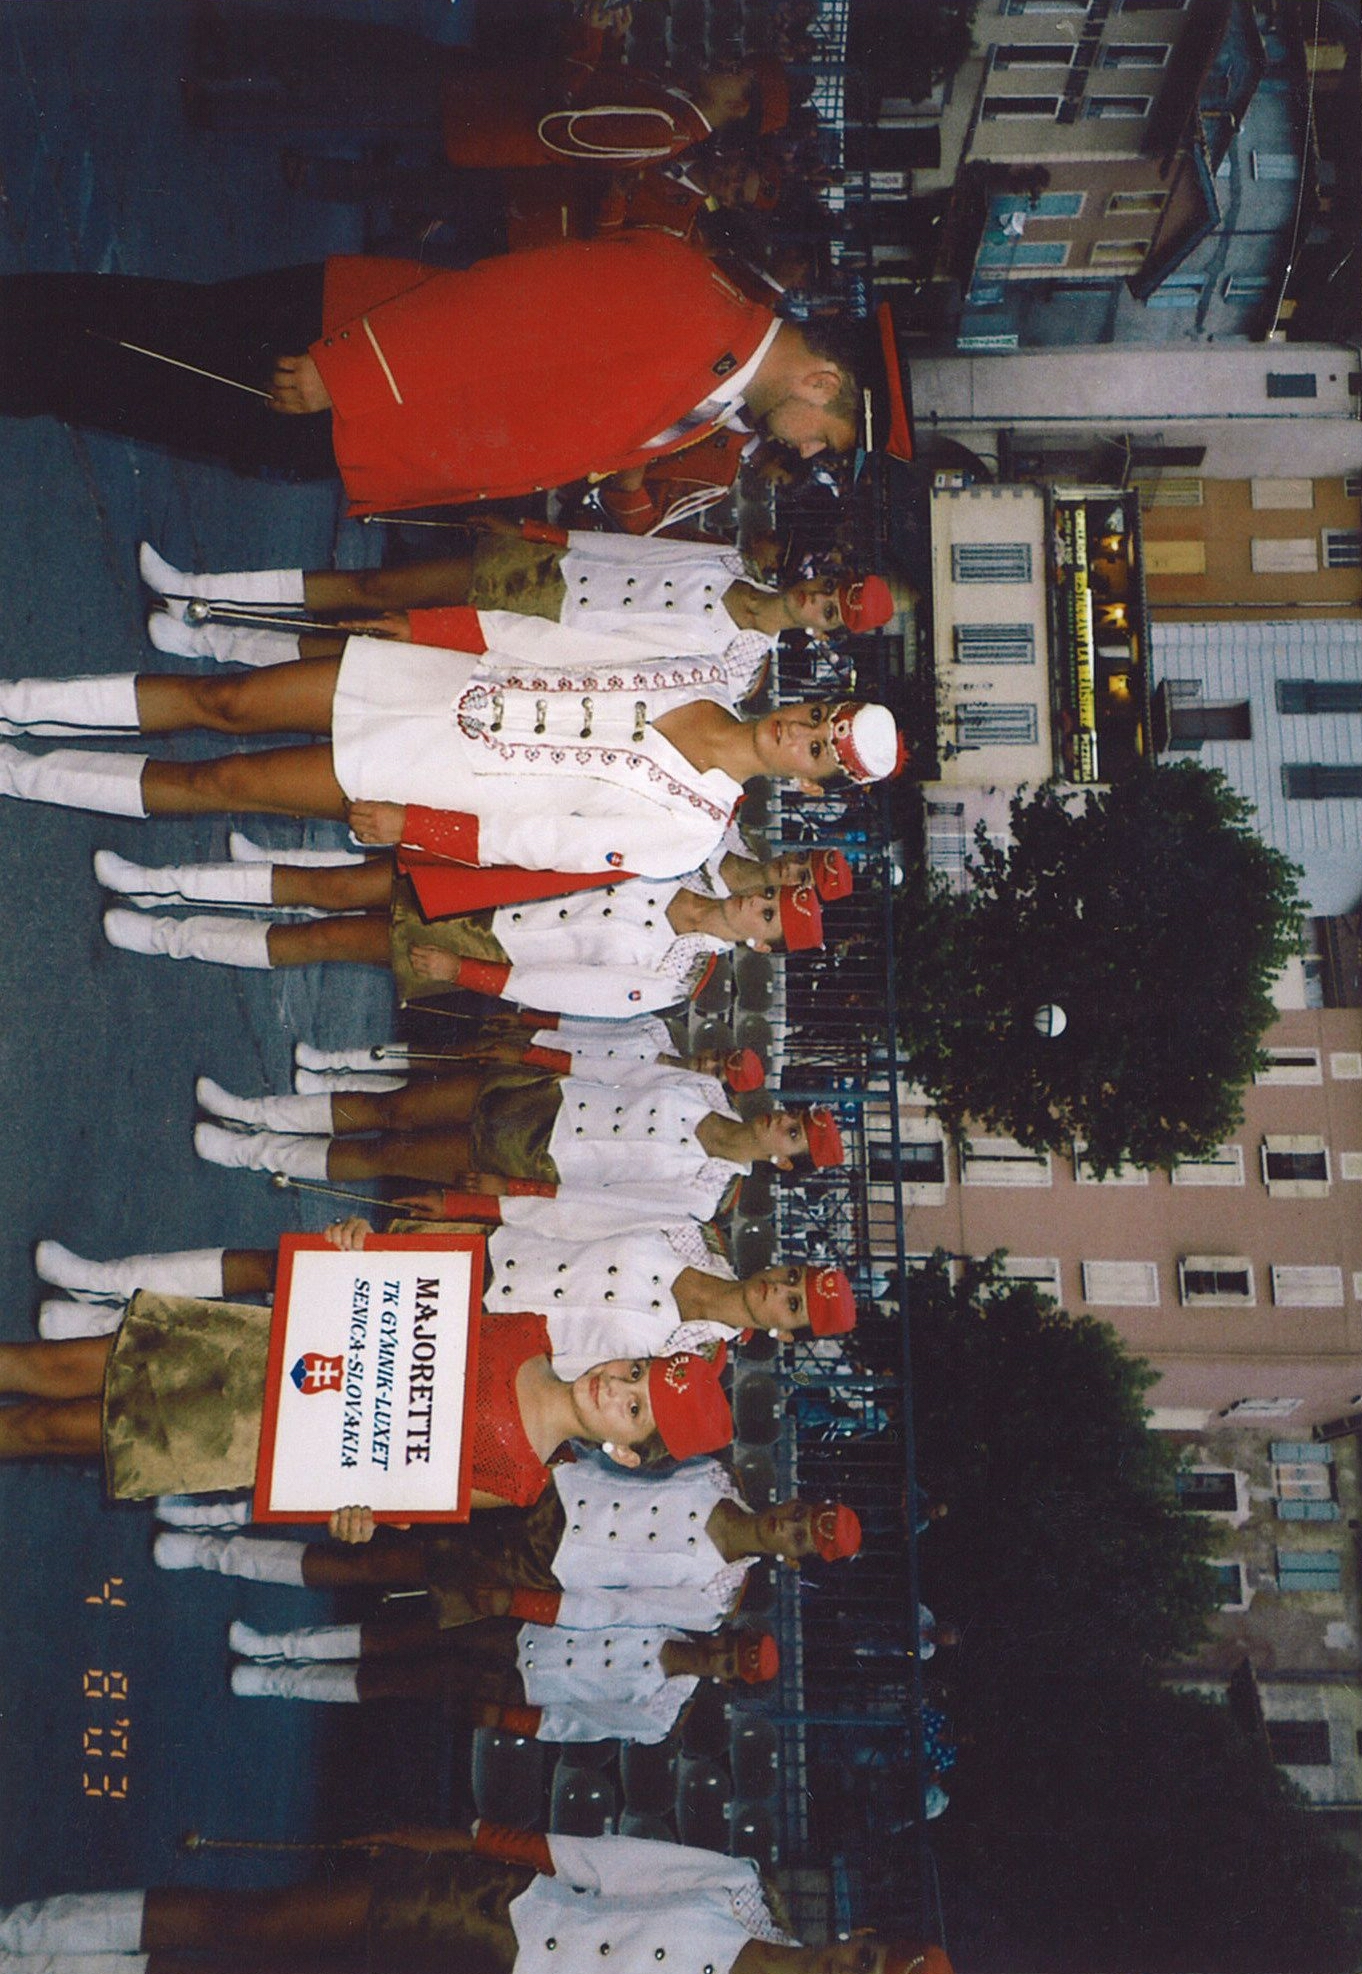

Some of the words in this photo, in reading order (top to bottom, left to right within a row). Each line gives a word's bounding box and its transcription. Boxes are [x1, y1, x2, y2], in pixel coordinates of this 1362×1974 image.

[1074, 571, 1088, 642] RESTAURANT
[1077, 648, 1090, 661] LA
[1080, 734, 1091, 782] PIZZERIA
[382, 1280, 400, 1306] TK
[341, 1278, 370, 1469] SENICA-SLOVAKIA
[372, 1310, 398, 1471] GYMNIK-LUXET
[406, 1278, 440, 1466] MAJORETTE
